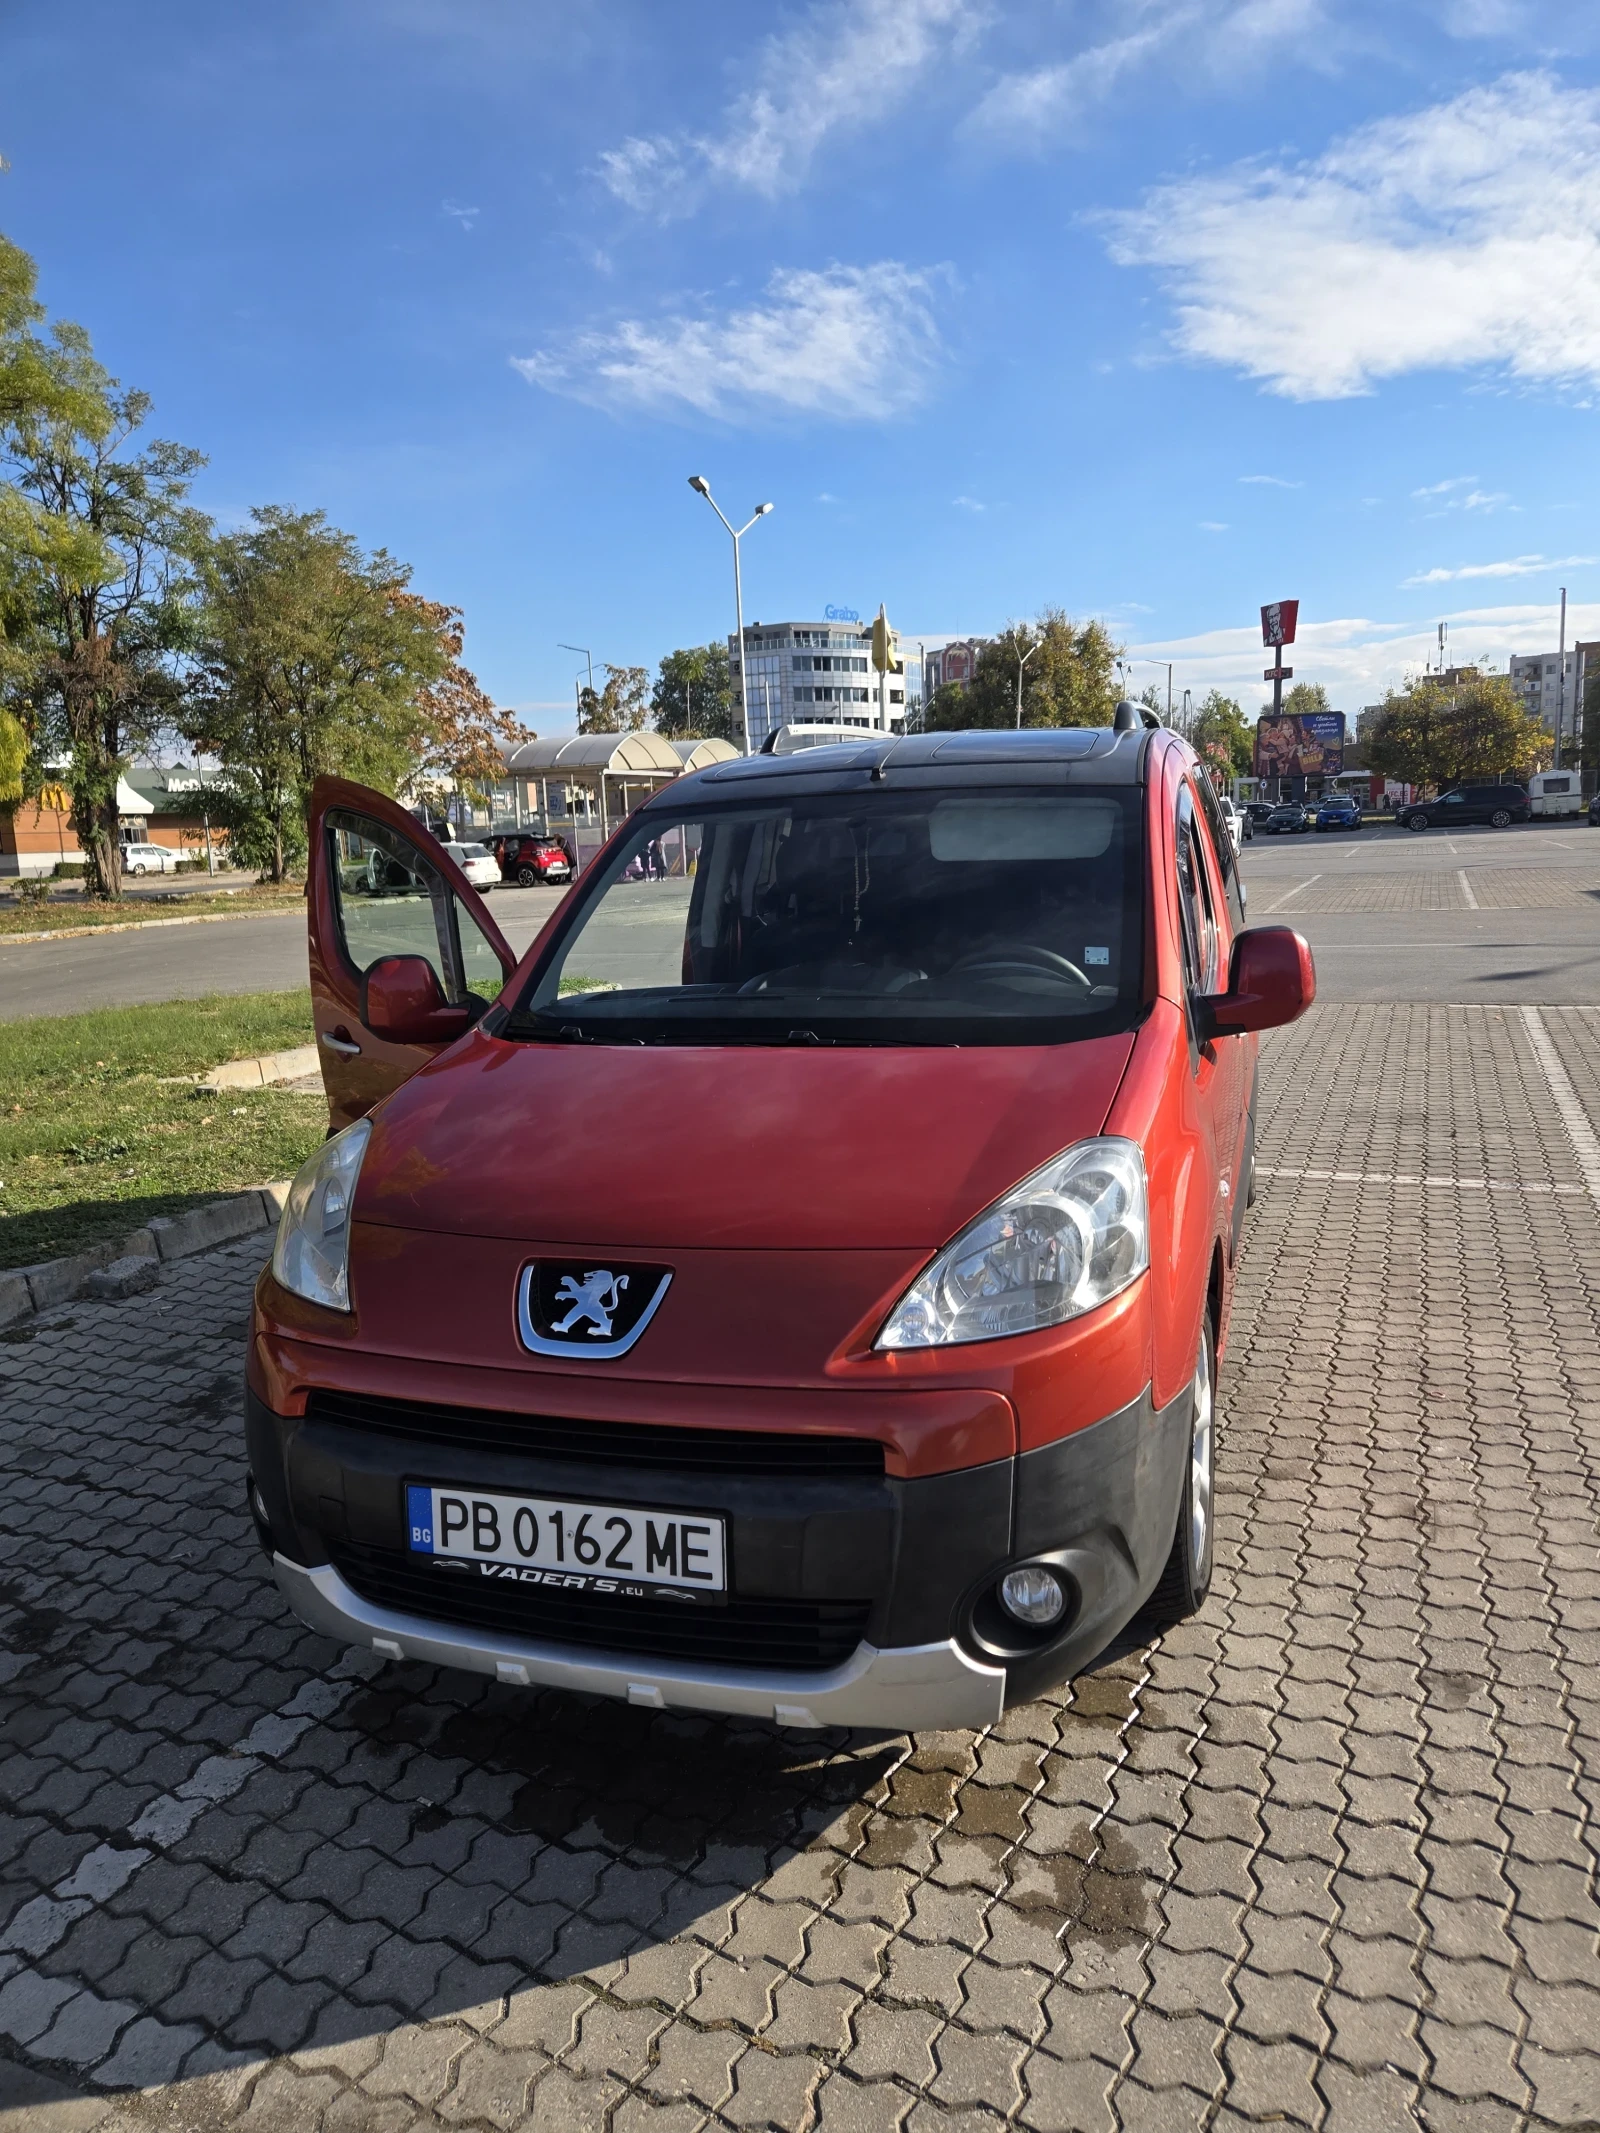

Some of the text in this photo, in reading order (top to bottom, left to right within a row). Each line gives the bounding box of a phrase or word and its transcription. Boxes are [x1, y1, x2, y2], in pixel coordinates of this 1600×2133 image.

[825, 604, 859, 621] Grabo
[1265, 669, 1279, 679] KFC
[412, 1526, 432, 1544] BG
[440, 1497, 713, 1581] PB 0162 ME
